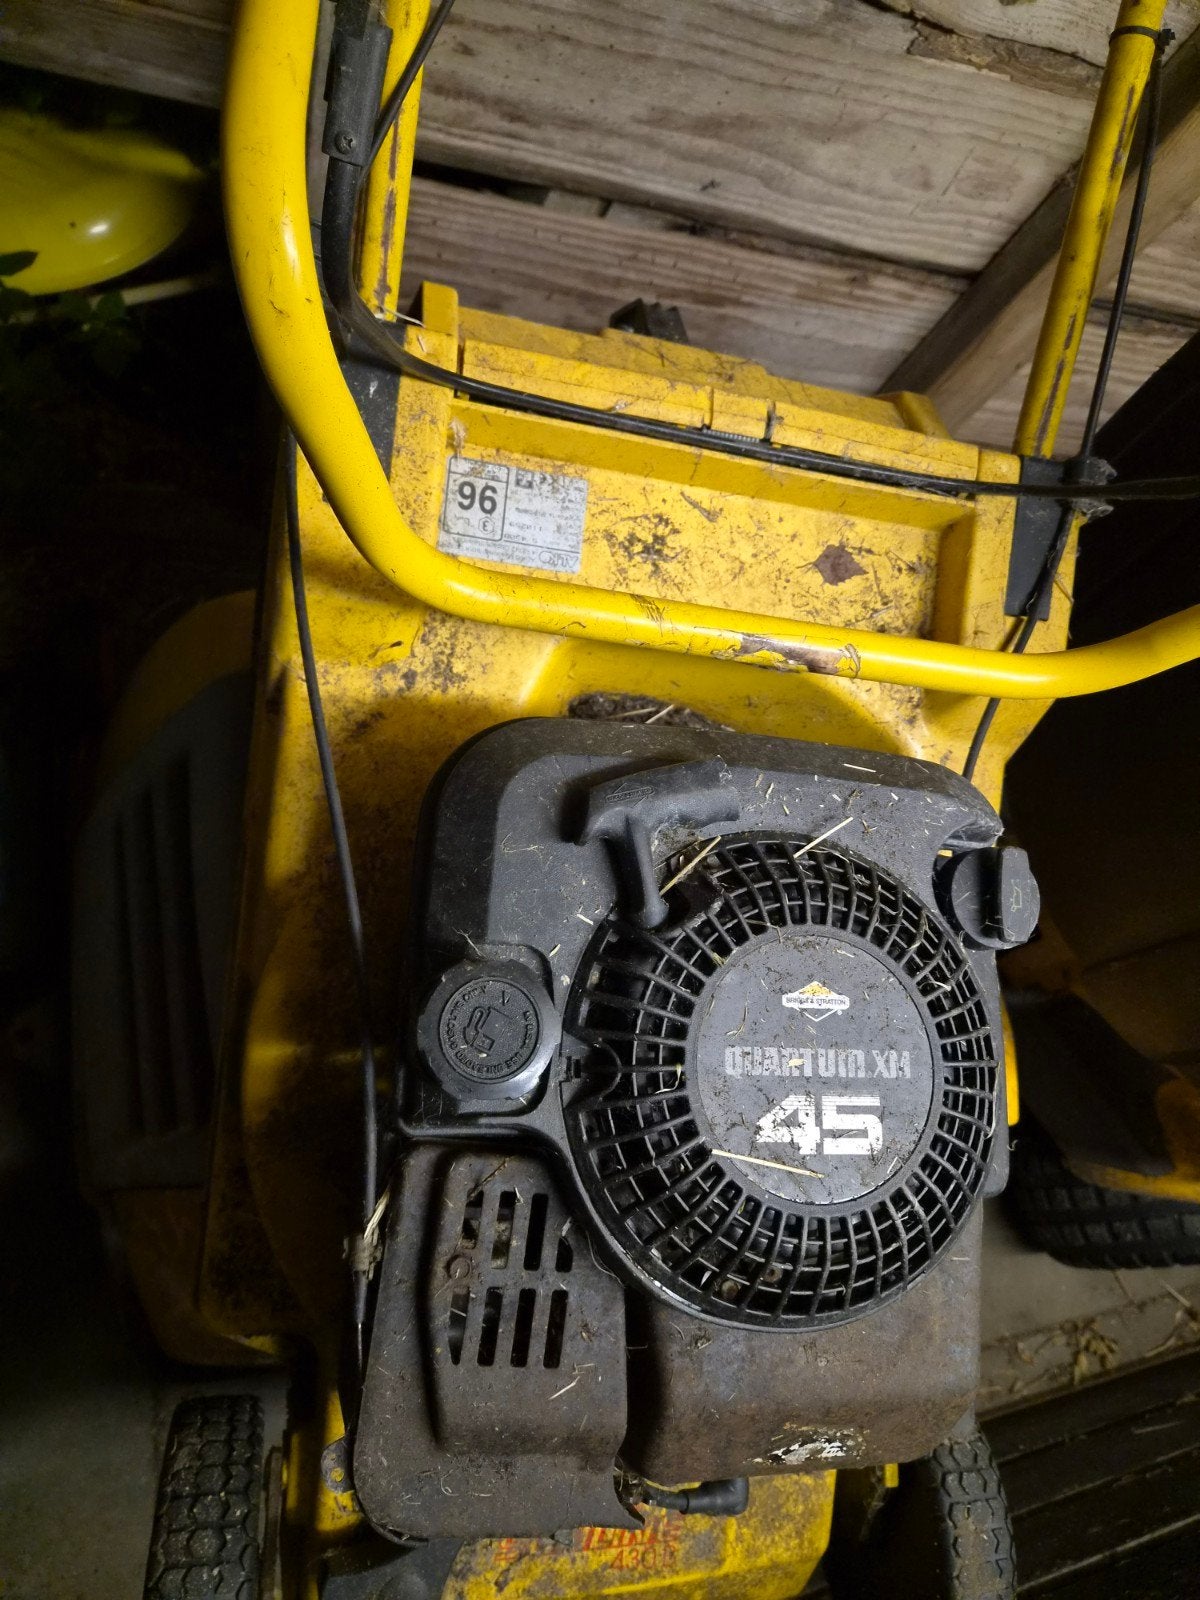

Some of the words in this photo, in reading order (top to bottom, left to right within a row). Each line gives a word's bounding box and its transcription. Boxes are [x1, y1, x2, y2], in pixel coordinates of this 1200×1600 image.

[457, 480, 498, 515] 96
[724, 1045, 866, 1079] QUANTUM
[871, 1049, 911, 1079] XM
[755, 1094, 883, 1155] 45
